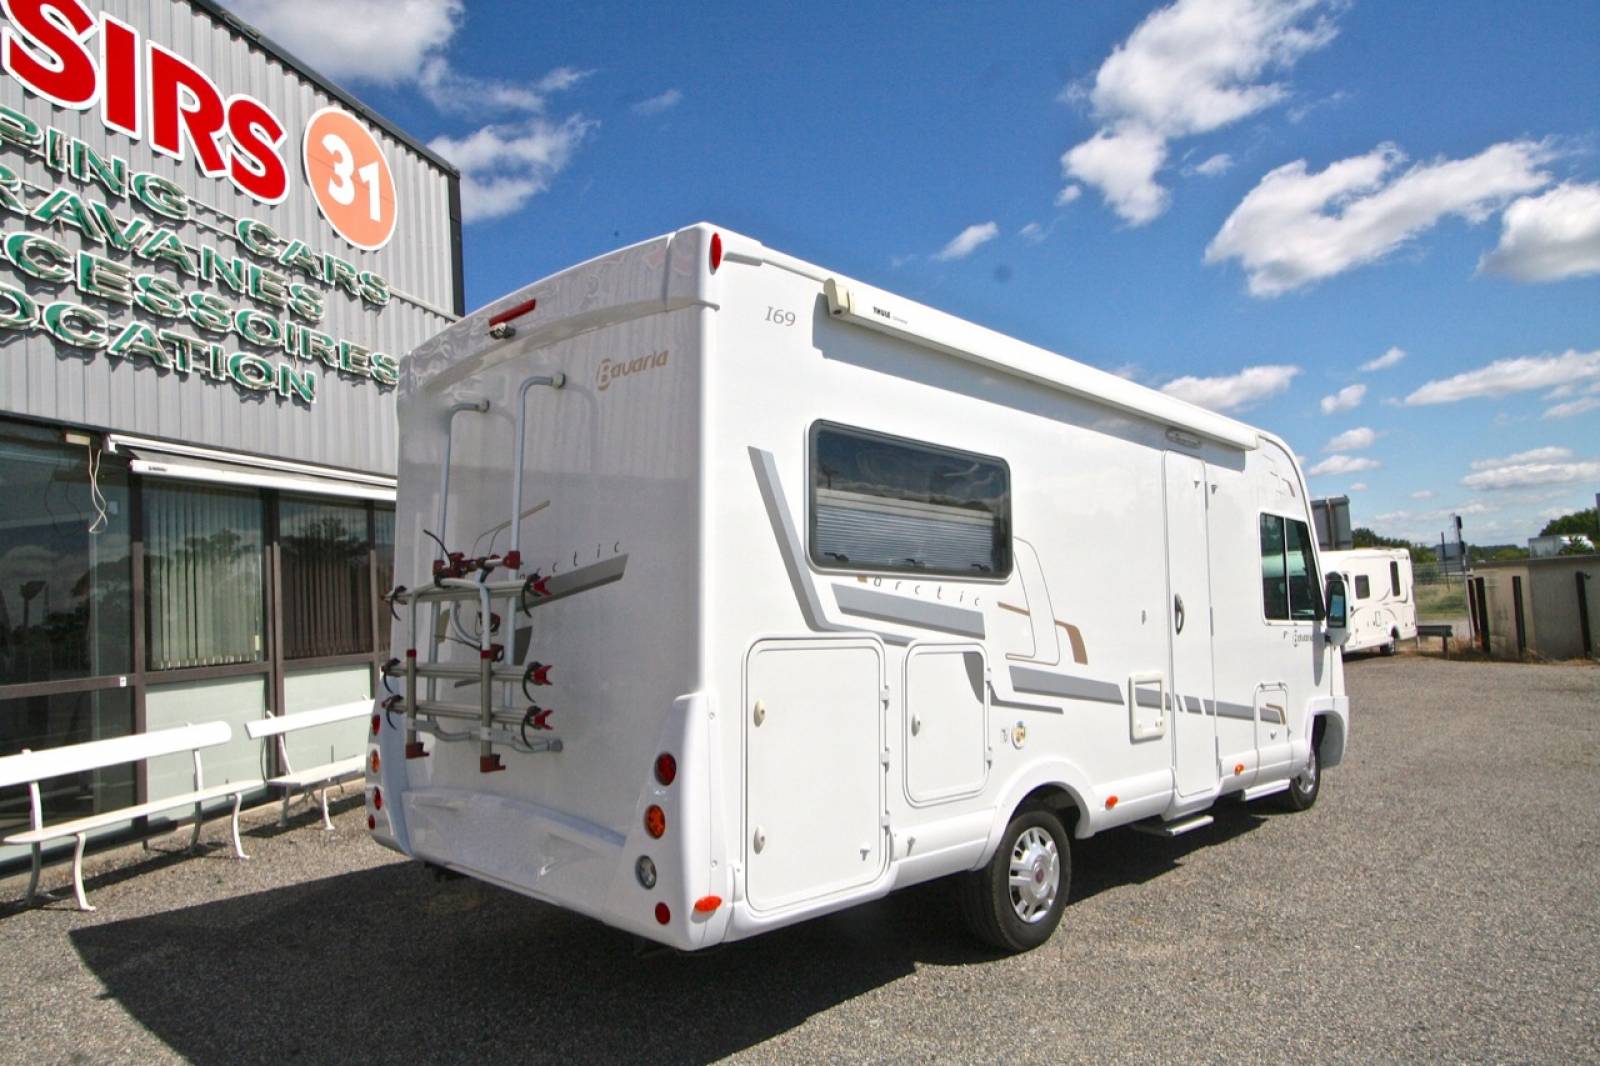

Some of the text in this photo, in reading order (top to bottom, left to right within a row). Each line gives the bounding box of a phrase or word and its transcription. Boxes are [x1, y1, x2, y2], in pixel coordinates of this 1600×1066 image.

[2, 0, 290, 206] SIRS
[322, 133, 382, 223] 31
[236, 217, 391, 306] CARS
[3, 231, 399, 386] CESSOIRES
[764, 305, 796, 327] I69
[596, 350, 669, 391] Bavaria
[873, 575, 980, 606] arctic
